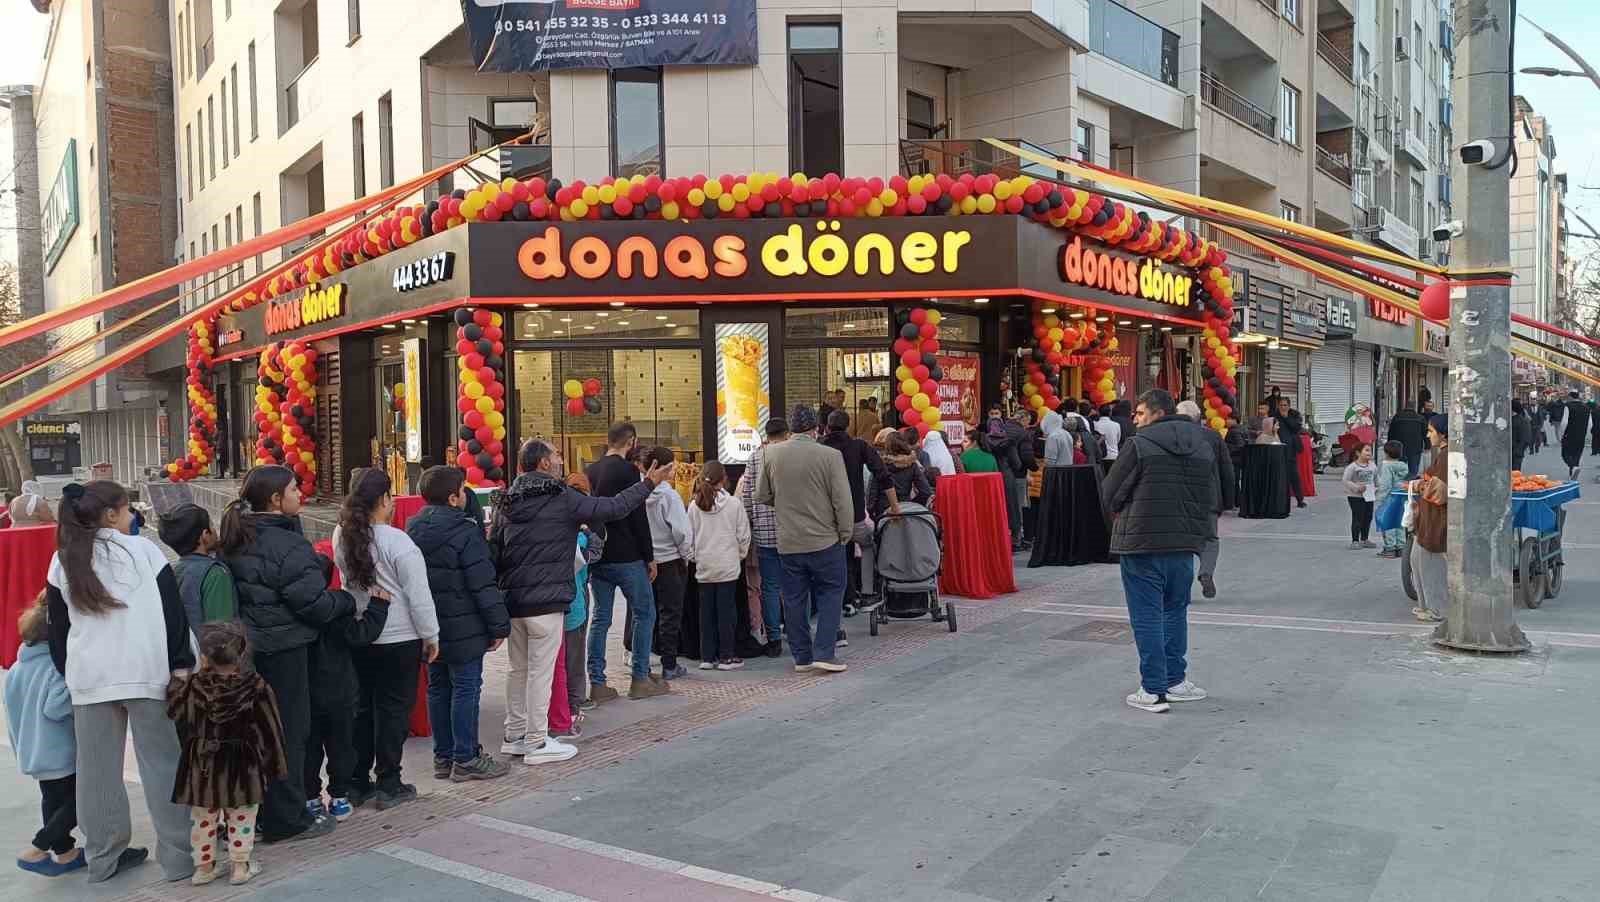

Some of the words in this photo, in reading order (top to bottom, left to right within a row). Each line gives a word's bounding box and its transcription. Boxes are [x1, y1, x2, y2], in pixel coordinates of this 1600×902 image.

[504, 20, 513, 31] 0
[516, 19, 540, 31] 541
[570, 16, 587, 27] 32
[592, 17, 609, 28] 35
[622, 18, 631, 29] 0
[634, 14, 658, 28] 533
[663, 13, 689, 25] 344
[693, 12, 708, 24] 41
[711, 13, 727, 25] 13
[393, 263, 413, 292] 444
[415, 258, 429, 287] 33
[431, 251, 447, 281] 67
[518, 226, 748, 280] donas
[761, 220, 971, 276] döner
[1065, 235, 1138, 295] donas
[1140, 257, 1192, 306] döner
[264, 298, 301, 336] donas
[302, 282, 342, 326] döner
[936, 384, 958, 399] ATMAN
